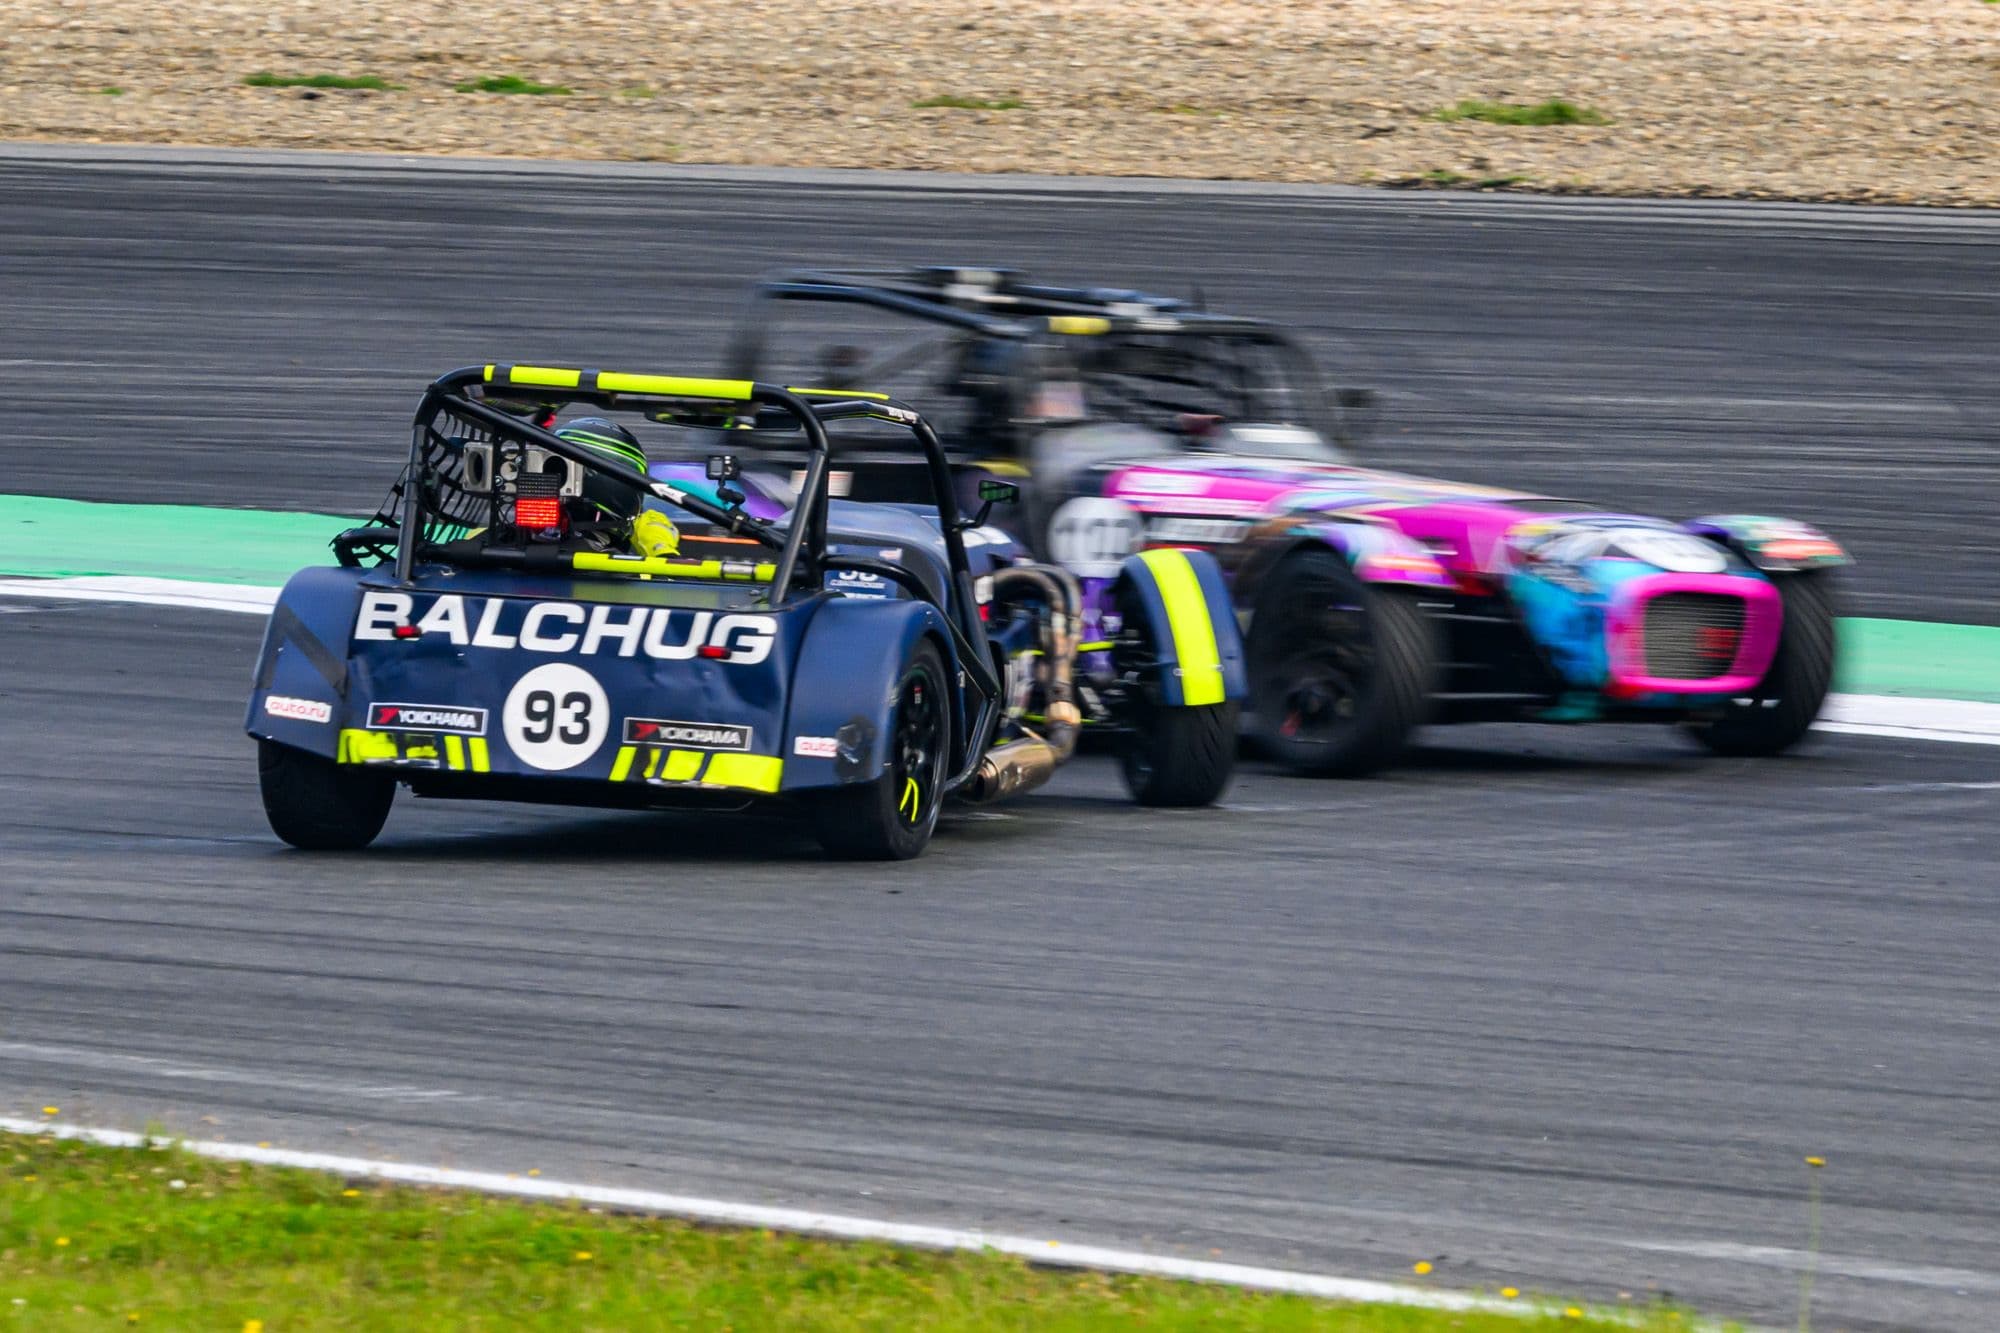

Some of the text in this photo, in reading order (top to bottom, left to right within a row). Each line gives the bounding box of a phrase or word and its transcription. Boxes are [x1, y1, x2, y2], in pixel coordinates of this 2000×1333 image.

[354, 591, 778, 665] BALCHUG
[271, 701, 326, 718] auto.ru
[397, 709, 477, 729] YOKOHAMA
[522, 690, 592, 745] 93
[658, 725, 741, 745] YOKOHAMA
[800, 740, 838, 753] auto
